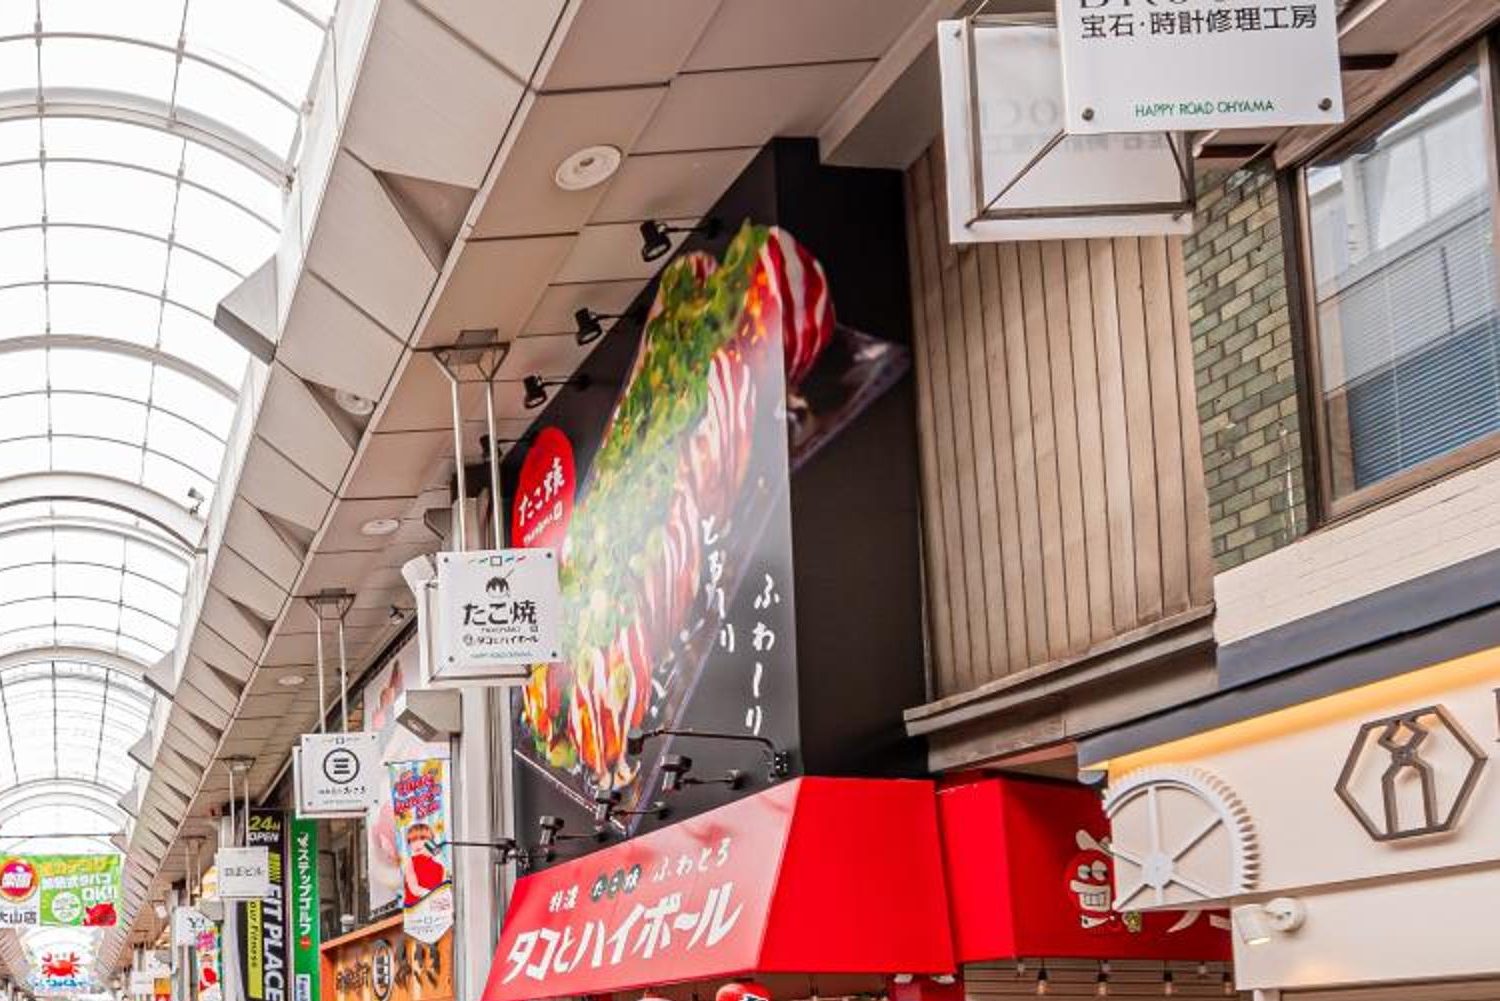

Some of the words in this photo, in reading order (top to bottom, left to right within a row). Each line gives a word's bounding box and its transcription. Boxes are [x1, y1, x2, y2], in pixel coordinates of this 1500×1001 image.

[1081, 5, 1317, 39] 宝石・時計修理工房
[1135, 103, 1174, 117] HAPPY
[1179, 102, 1213, 115] ROAD
[1217, 100, 1274, 114] OHYAMA
[462, 599, 538, 625] たこ焼
[745, 573, 781, 737] ふわーり
[502, 881, 744, 986] タコとハイボール
